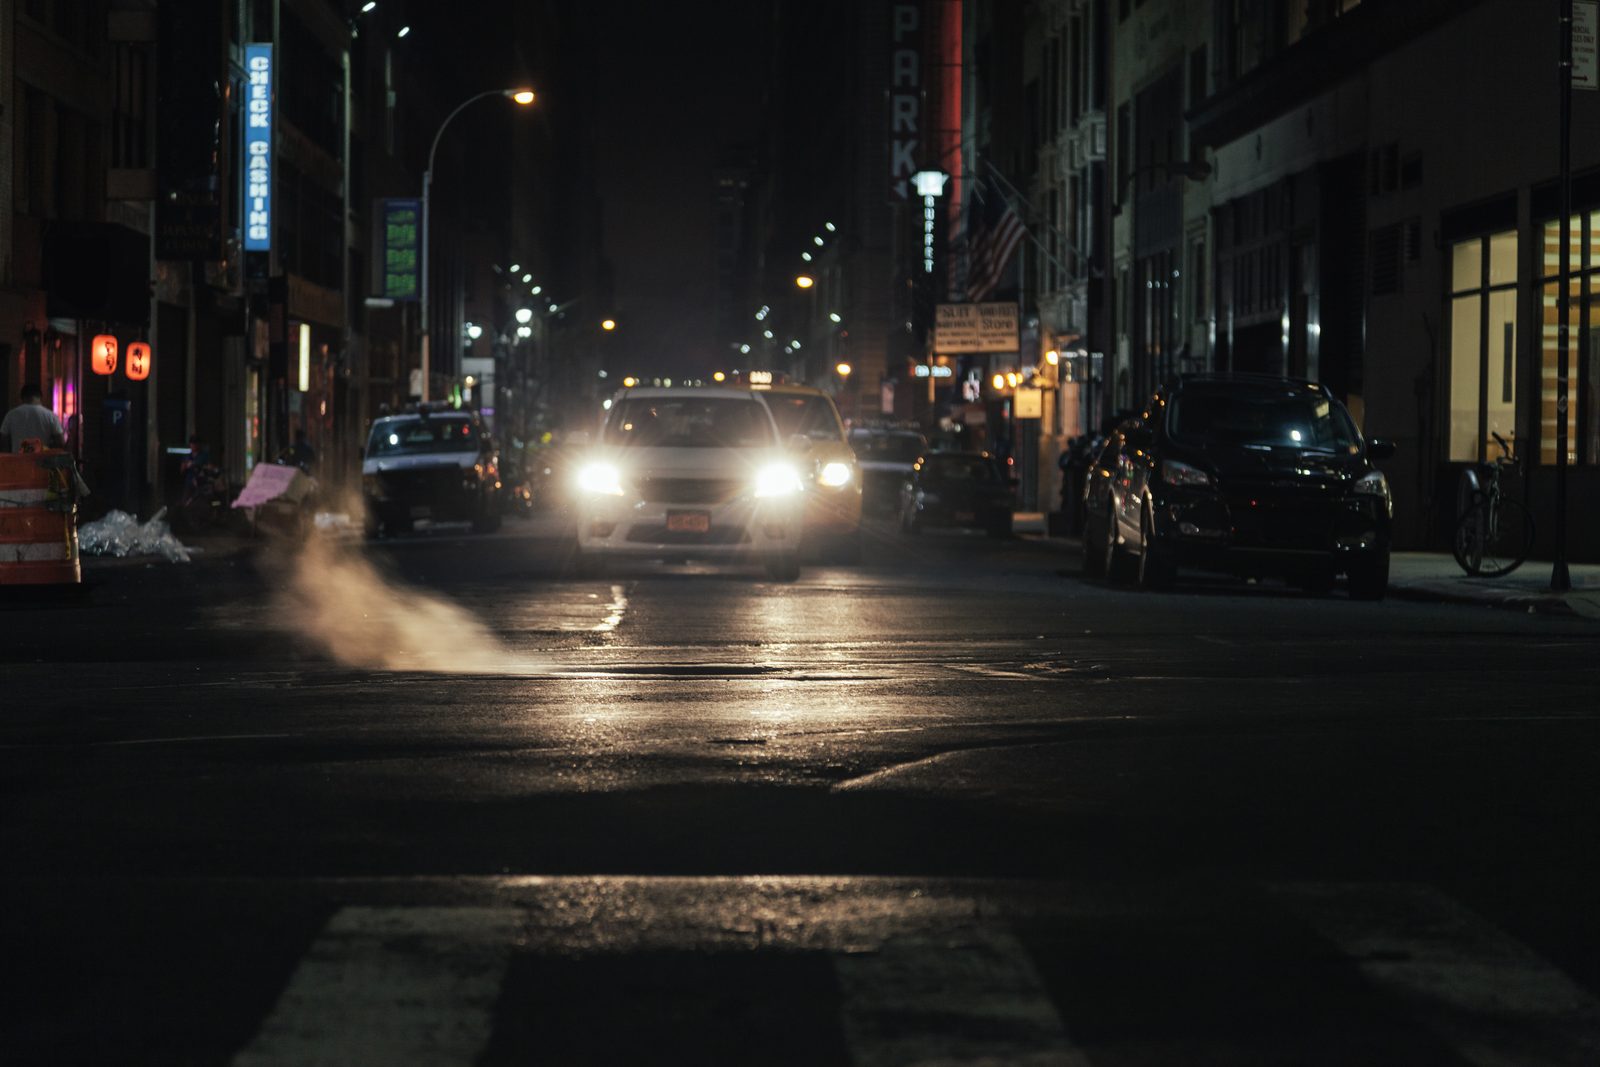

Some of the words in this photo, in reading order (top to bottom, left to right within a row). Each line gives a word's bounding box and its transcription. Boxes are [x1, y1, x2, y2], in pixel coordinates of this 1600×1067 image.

[249, 56, 269, 128] CHECK
[893, 5, 919, 177] PARK
[249, 141, 268, 240] CASHING
[924, 195, 935, 272] BUFFET
